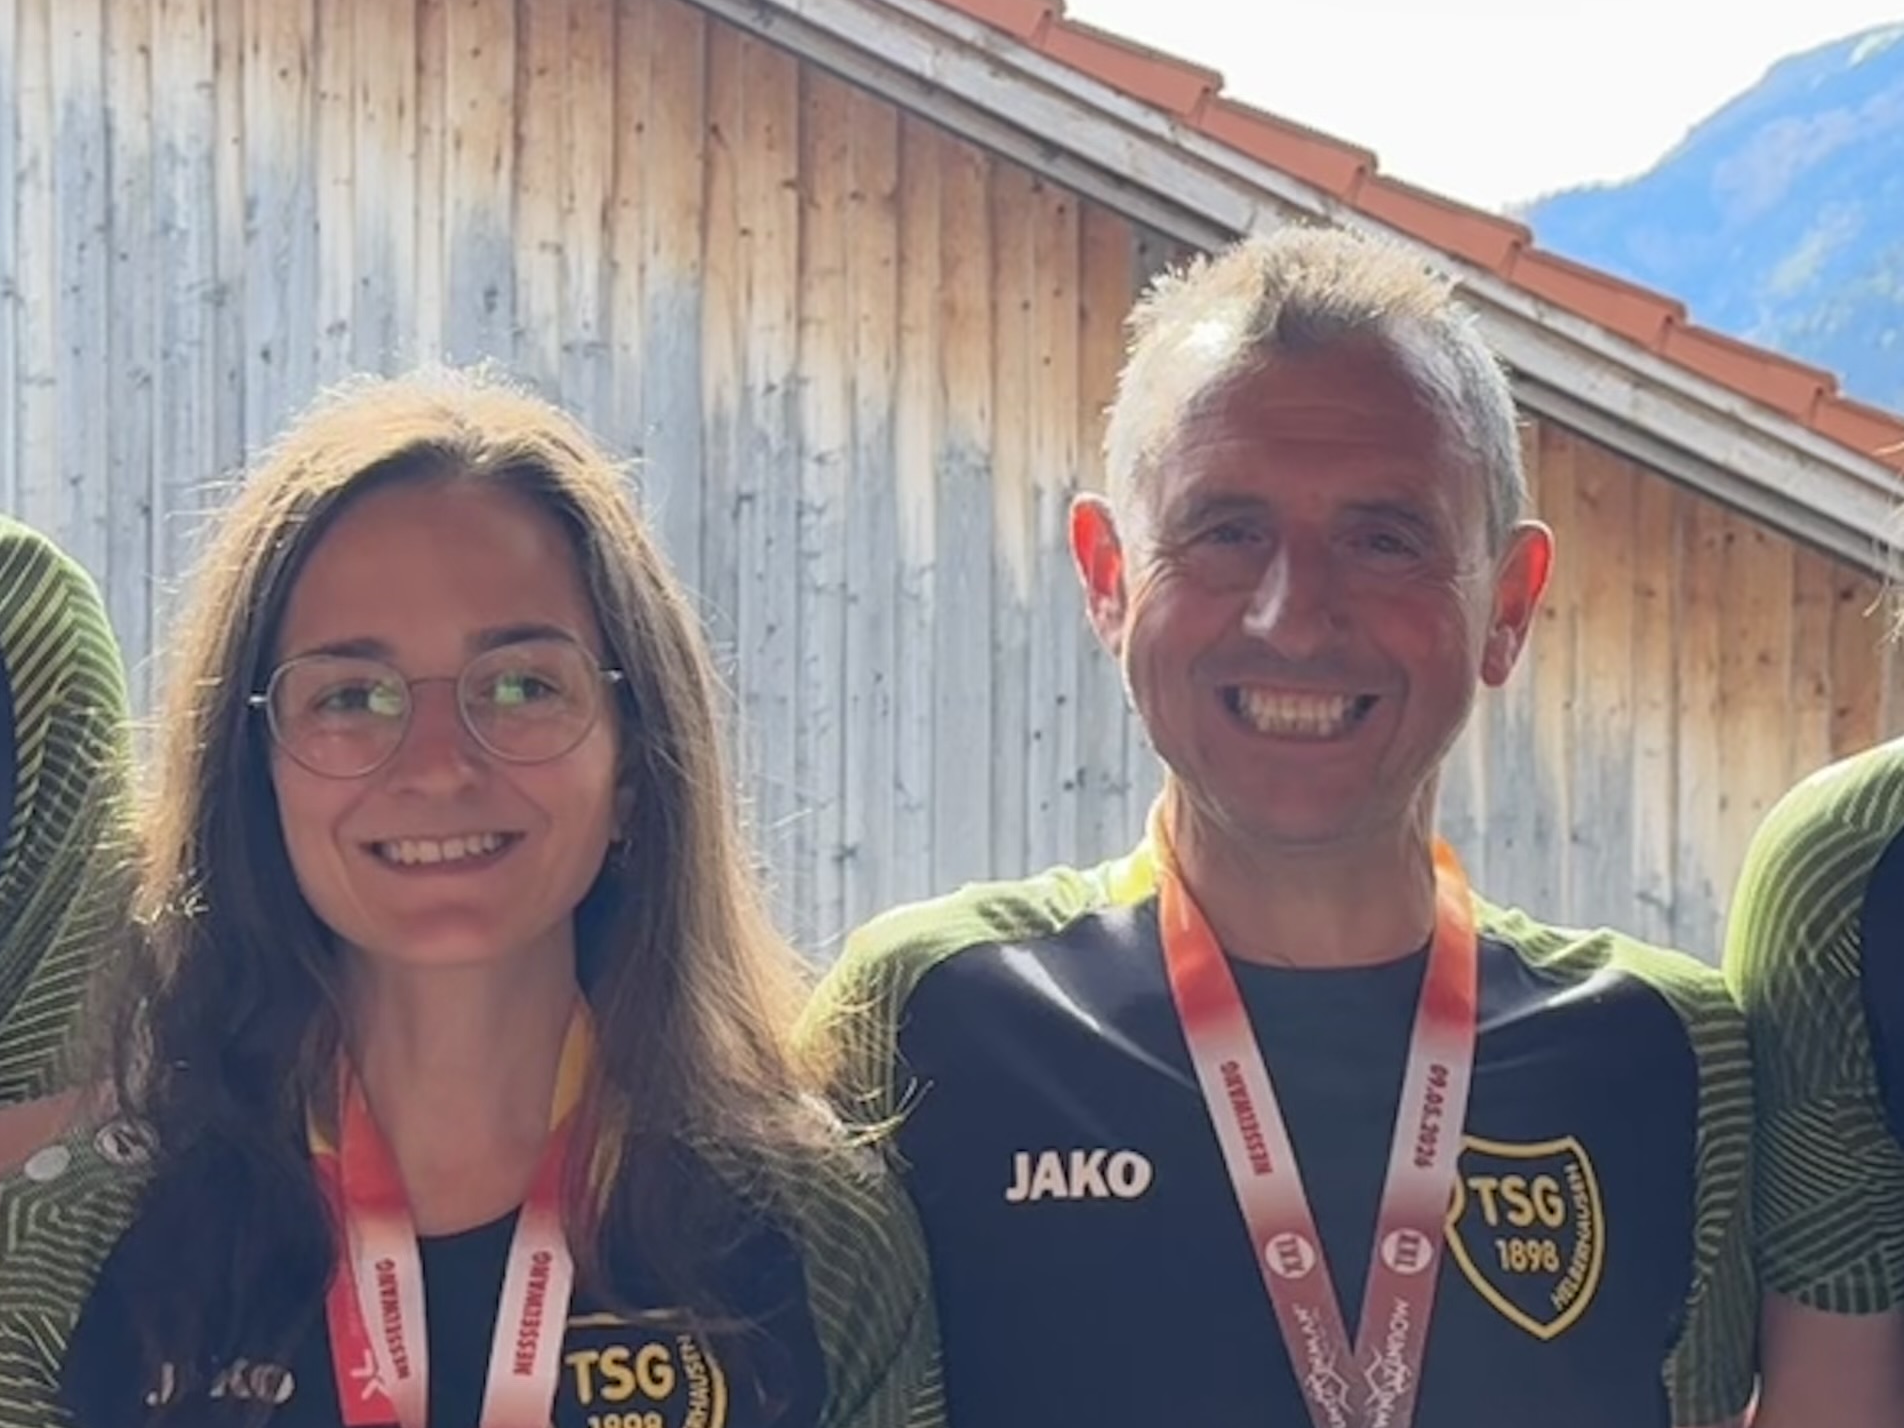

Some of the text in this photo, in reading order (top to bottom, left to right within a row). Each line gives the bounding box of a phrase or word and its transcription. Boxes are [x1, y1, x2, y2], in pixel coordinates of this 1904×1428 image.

[1005, 1147, 1153, 1202] JAKO
[1467, 1174, 1565, 1227] TSG
[1495, 1237, 1560, 1272] 1898
[513, 1250, 554, 1378] NESSELWANG
[564, 1343, 675, 1405] TSG
